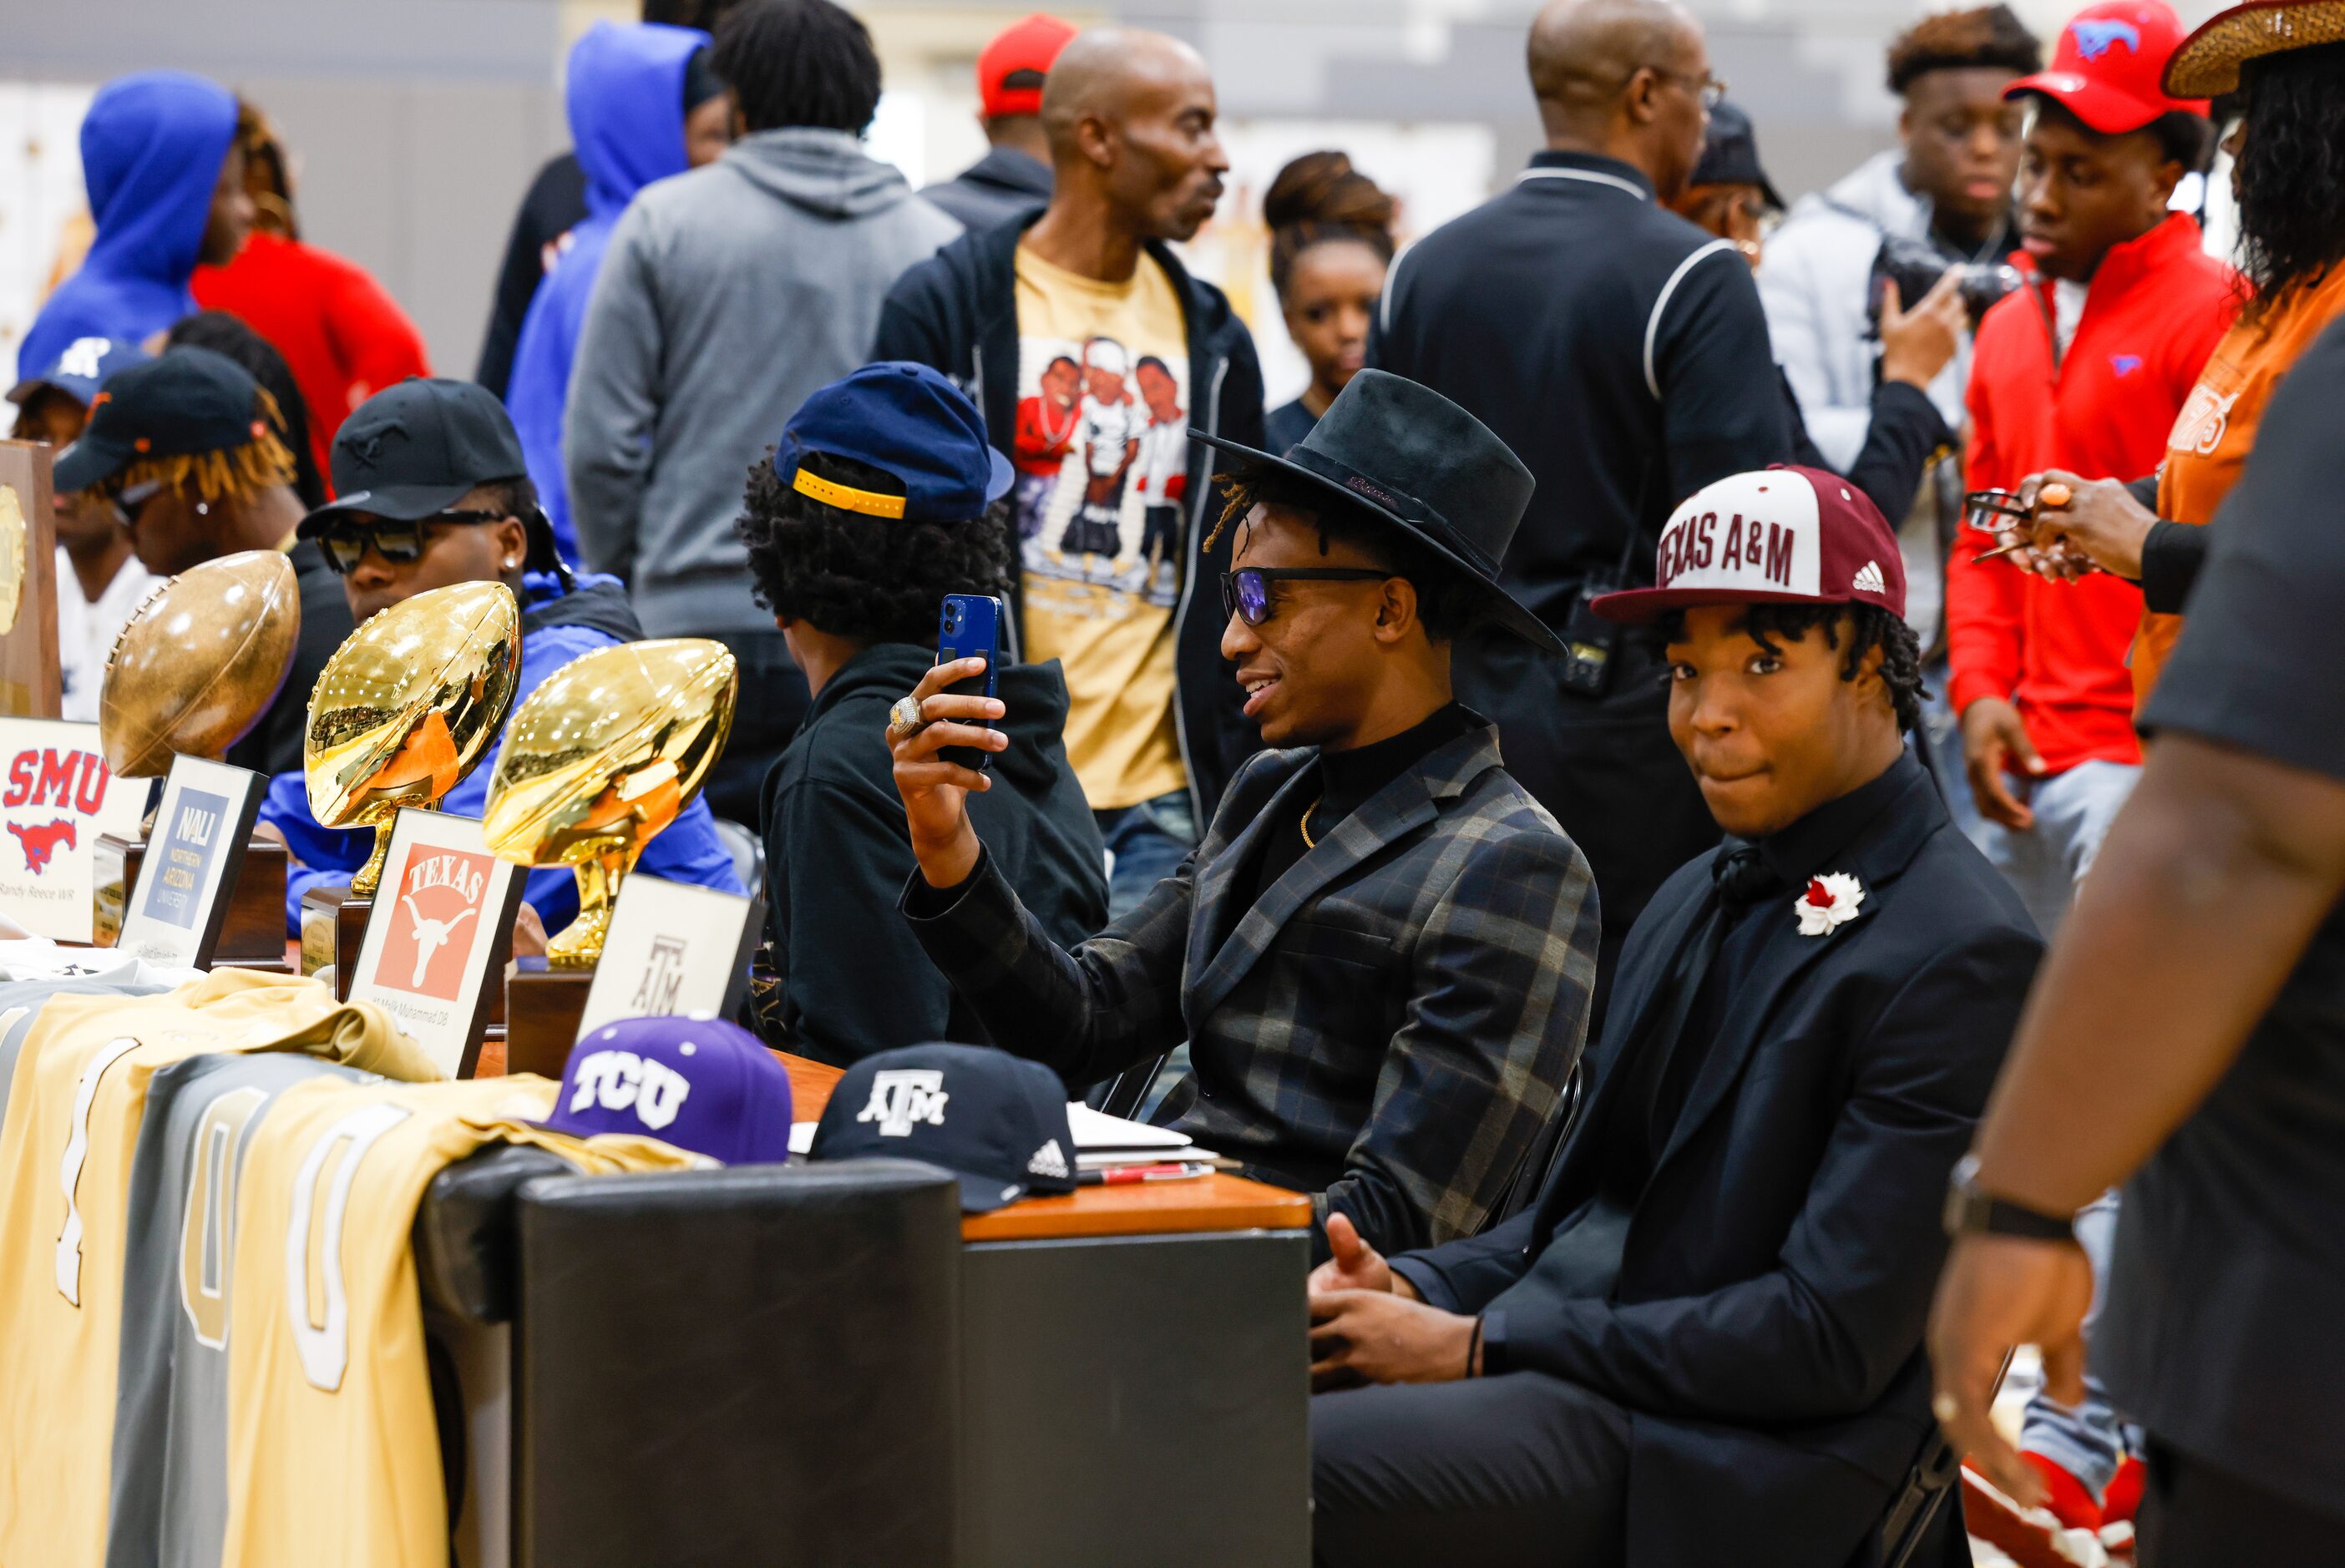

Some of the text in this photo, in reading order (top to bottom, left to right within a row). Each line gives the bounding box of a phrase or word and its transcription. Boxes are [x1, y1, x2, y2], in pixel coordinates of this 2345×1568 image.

[1657, 512, 1795, 589] TEXAS A&M
[3, 748, 113, 817] SMU
[175, 806, 216, 847] NAU
[162, 866, 195, 891] ARIZONA
[170, 847, 202, 868] NORTHERN
[408, 854, 484, 904] TEXAS
[569, 1050, 690, 1130] TCU
